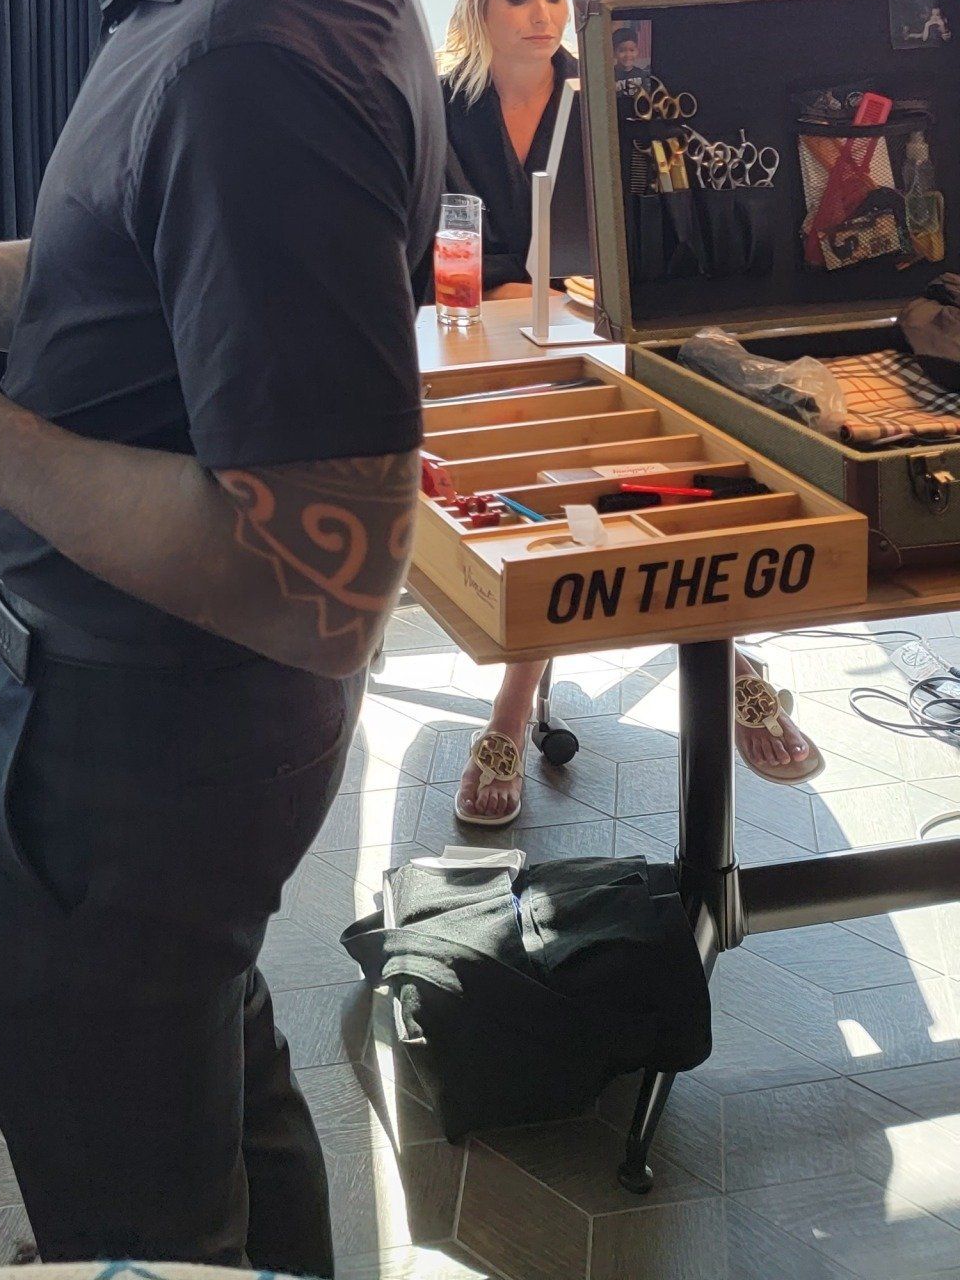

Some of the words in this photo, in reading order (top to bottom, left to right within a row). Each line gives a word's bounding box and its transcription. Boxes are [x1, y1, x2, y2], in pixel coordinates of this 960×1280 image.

[546, 567, 626, 624] ON
[637, 552, 739, 613] THE
[743, 543, 816, 599] GO
